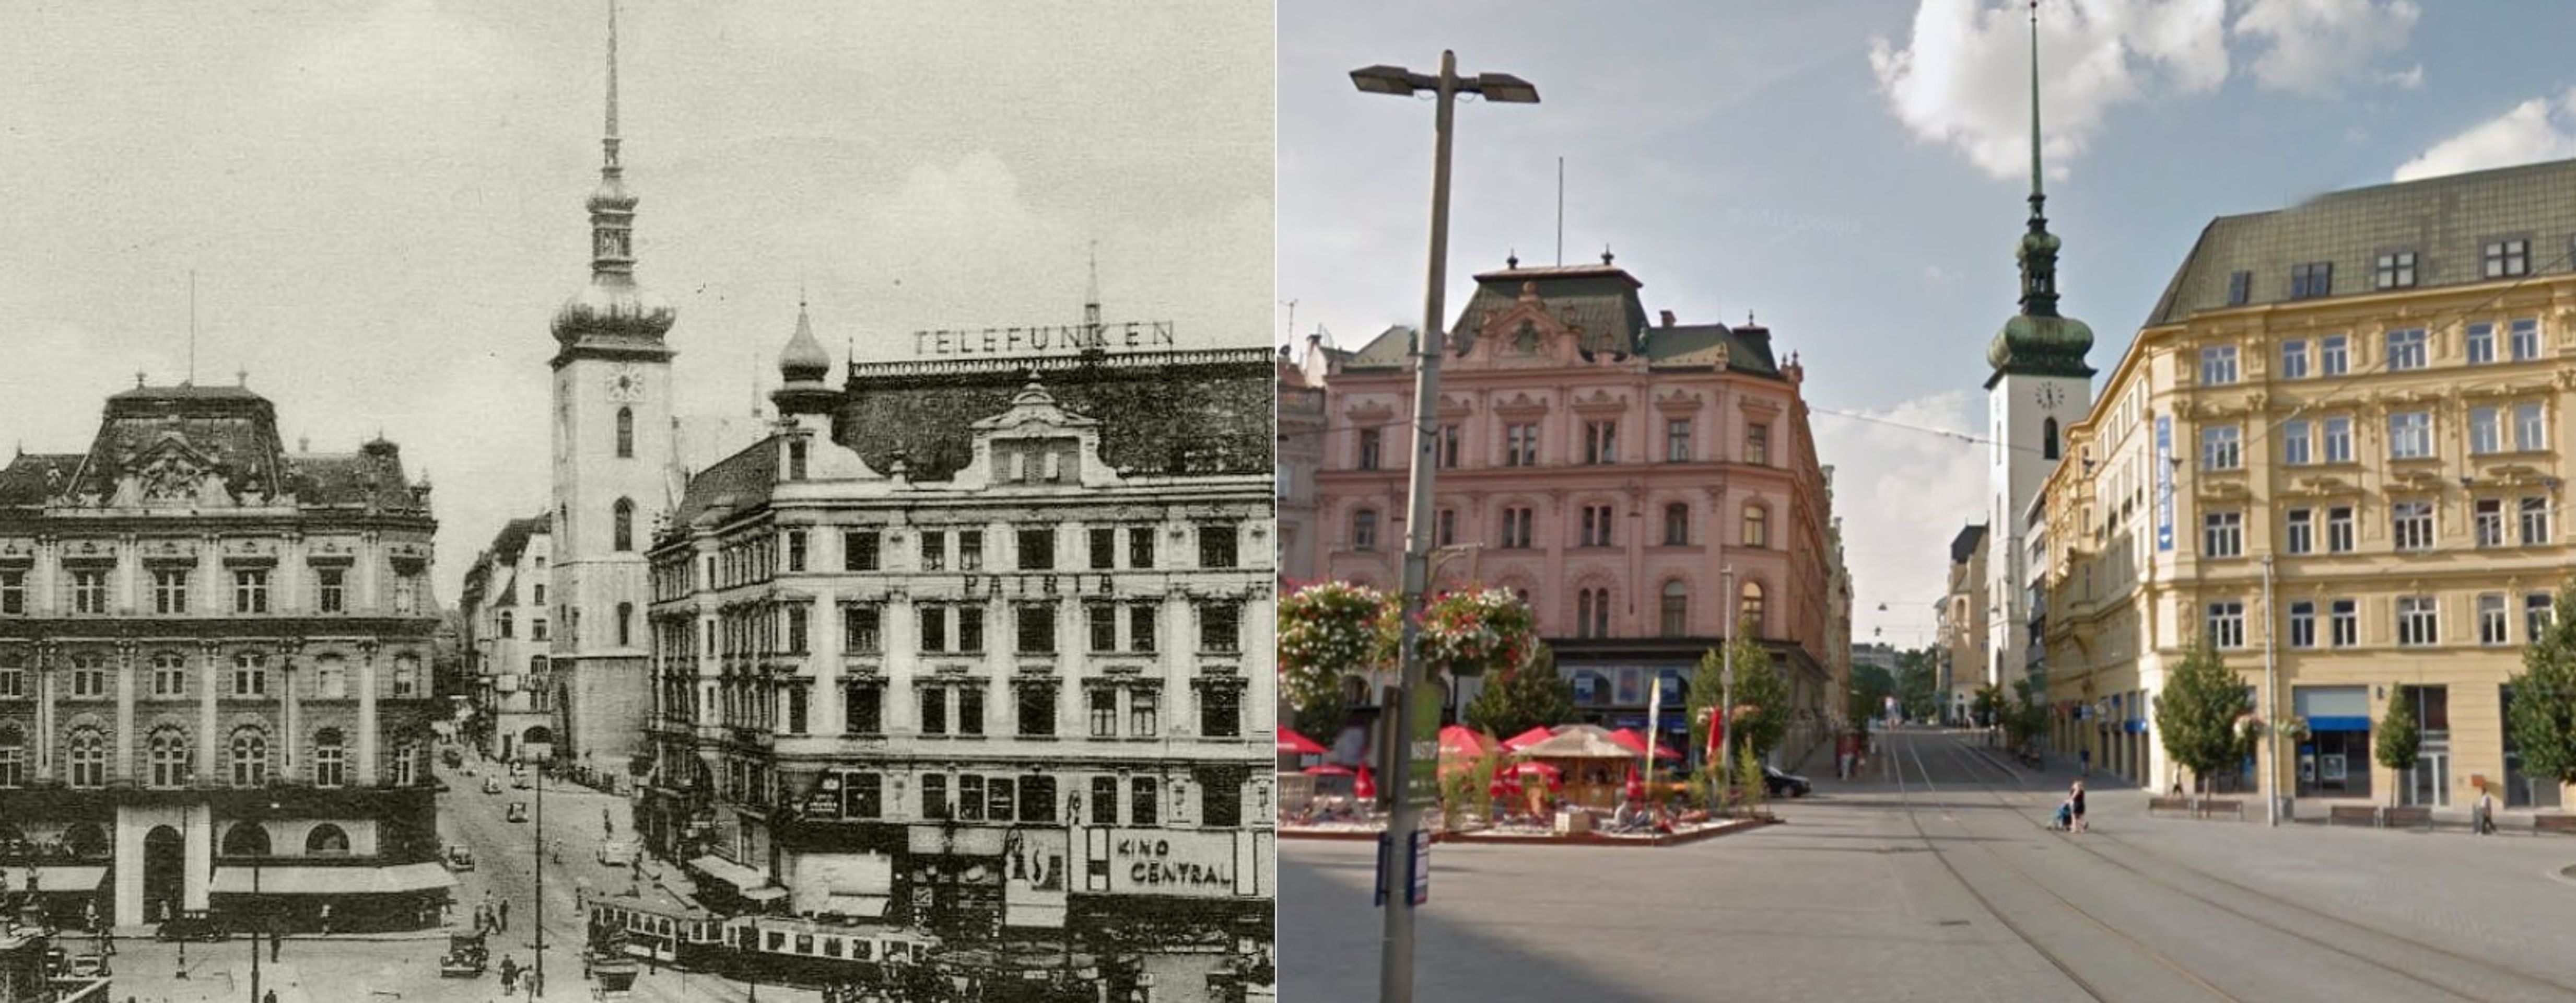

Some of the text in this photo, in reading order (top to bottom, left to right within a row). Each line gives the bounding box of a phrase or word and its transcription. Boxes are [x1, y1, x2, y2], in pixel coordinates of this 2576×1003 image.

[914, 321, 1174, 355] TELEFUNKEN
[1117, 838, 1169, 856] KINO
[1131, 862, 1231, 885] CENTRAL
